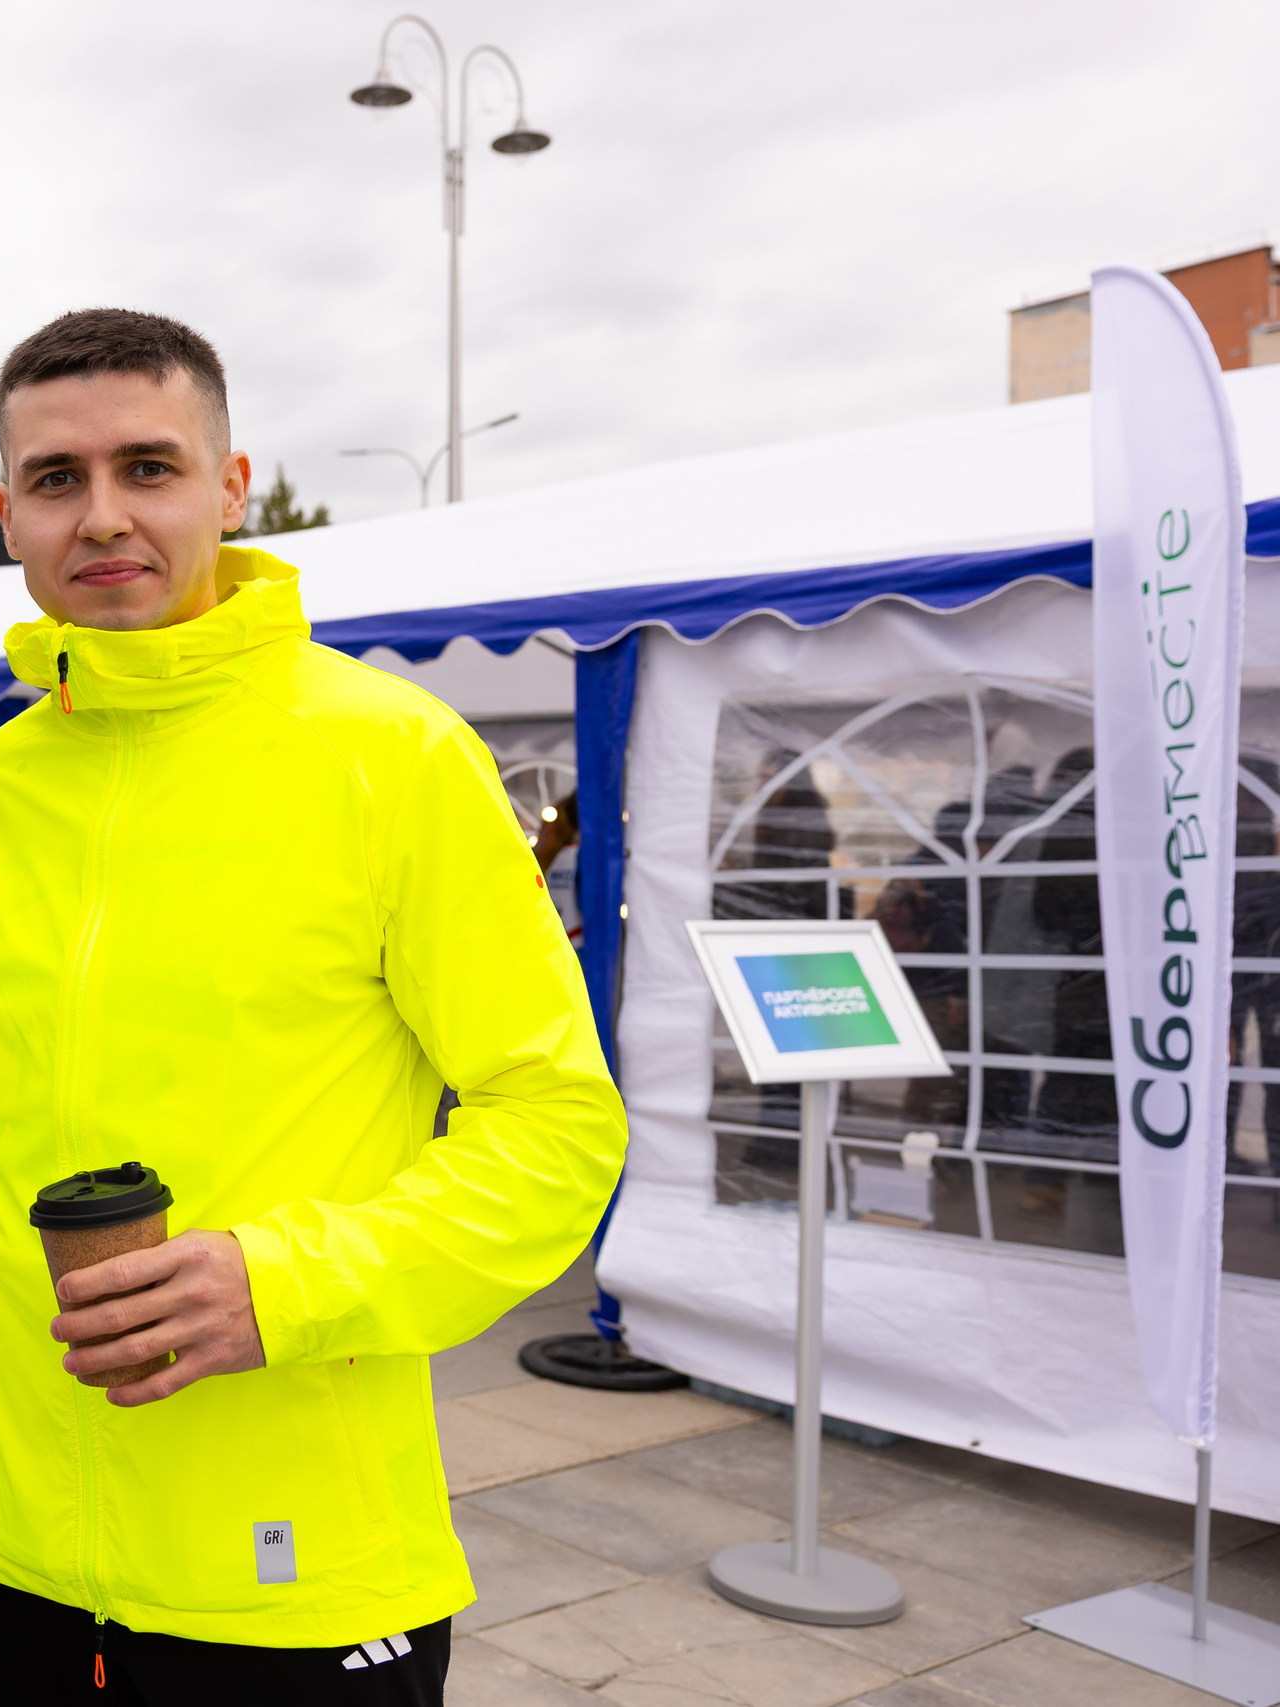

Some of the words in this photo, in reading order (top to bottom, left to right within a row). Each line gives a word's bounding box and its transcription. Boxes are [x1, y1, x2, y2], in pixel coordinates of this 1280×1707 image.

[762, 986, 868, 1006] ПАРТНЁРСКИЕ
[773, 1001, 871, 1019] АКТИВНОСТИ
[264, 1530, 284, 1545] GRi
